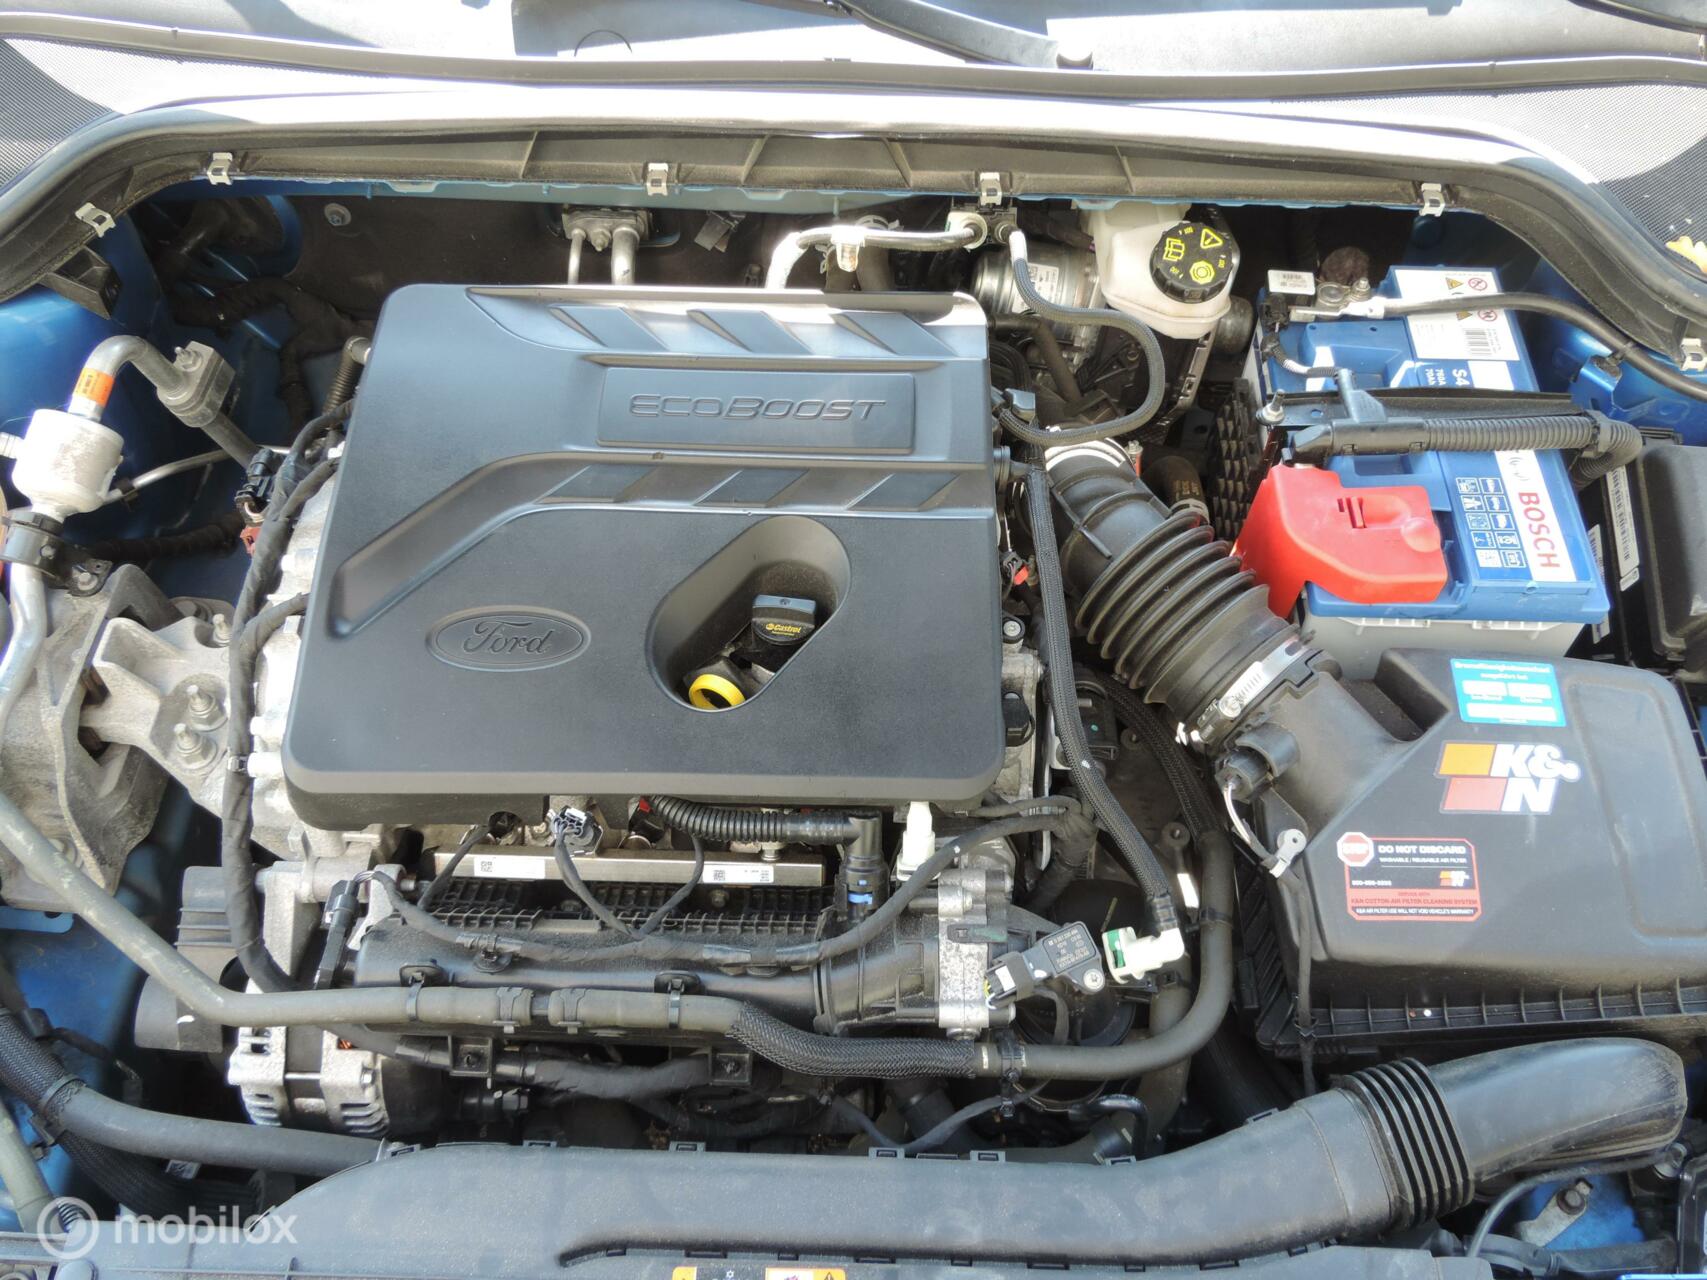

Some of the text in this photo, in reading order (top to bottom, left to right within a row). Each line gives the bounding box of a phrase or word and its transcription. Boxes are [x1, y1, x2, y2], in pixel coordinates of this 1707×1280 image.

[1452, 368, 1470, 386] S4
[1518, 491, 1561, 569] BOSCH
[462, 620, 555, 655] Ford
[774, 623, 802, 634] Castrol
[1378, 845, 1394, 854] DO
[1395, 845, 1418, 854] NOT
[1419, 845, 1466, 855] DISCARD
